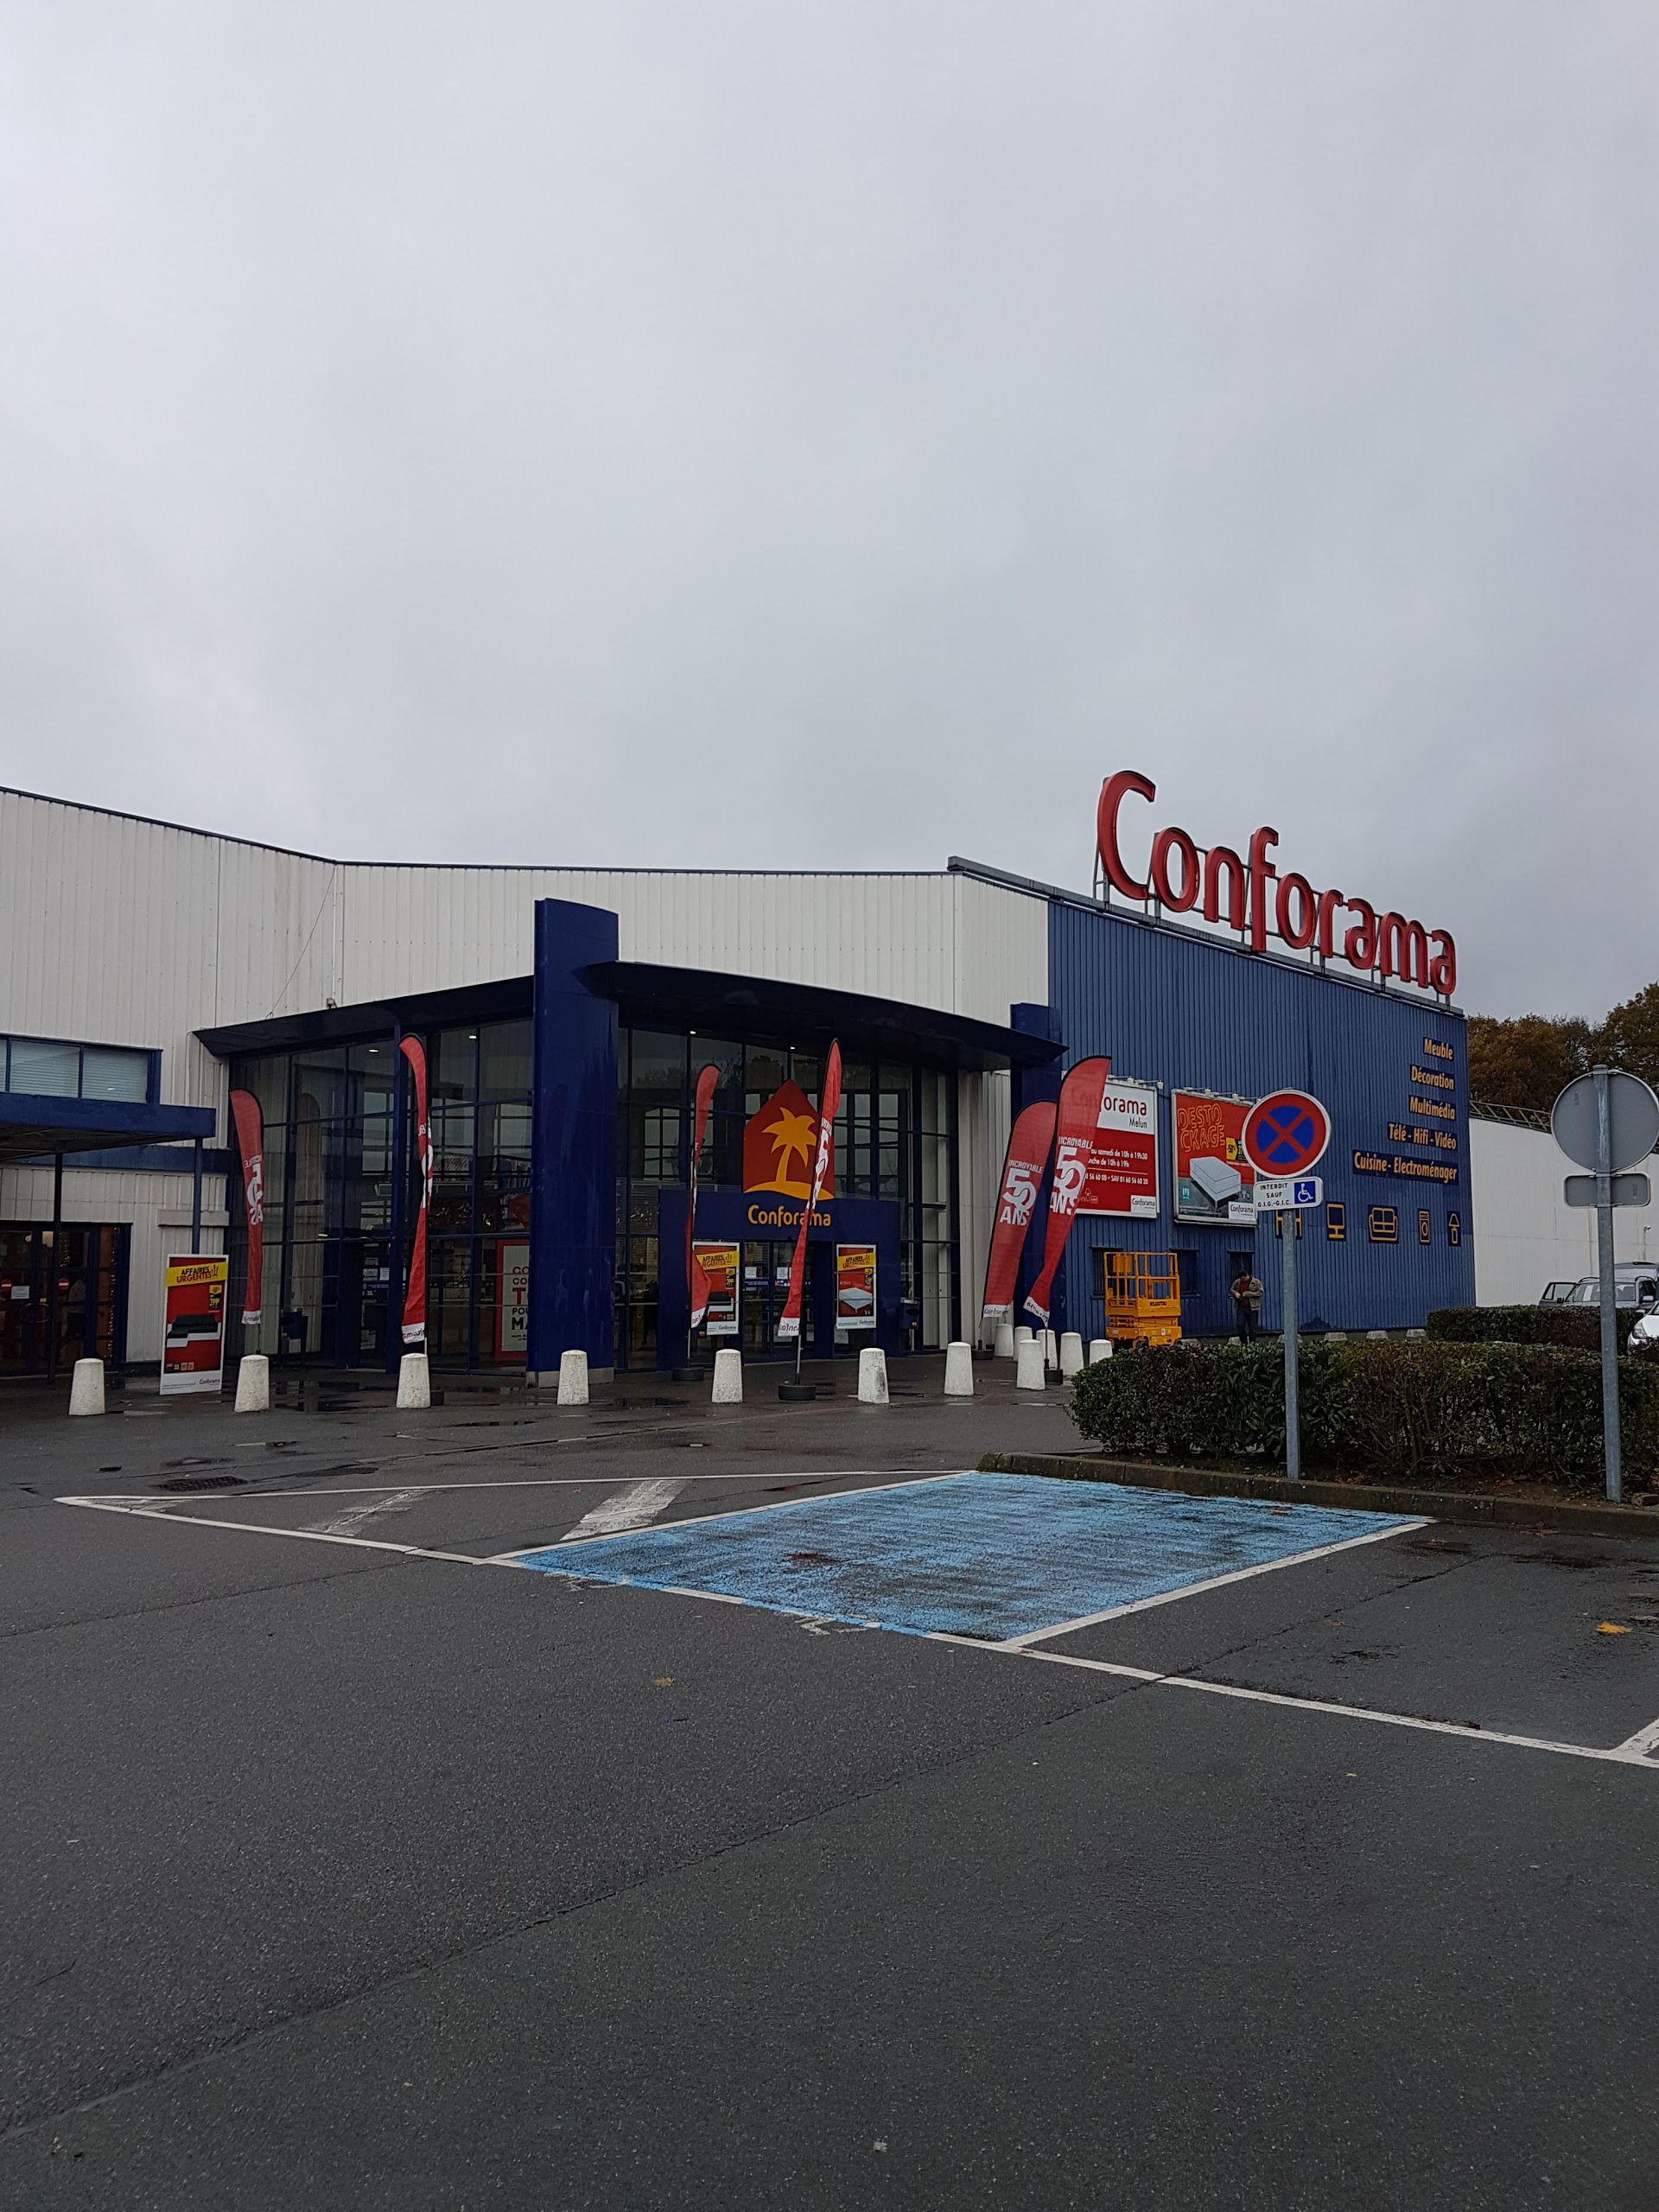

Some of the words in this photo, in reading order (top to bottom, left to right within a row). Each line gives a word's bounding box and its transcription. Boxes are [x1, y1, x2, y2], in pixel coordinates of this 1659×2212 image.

[1096, 770, 1457, 995] Conforama
[1424, 1039, 1453, 1060] Meuble
[1411, 1065, 1454, 1090] Décoration
[1102, 1096, 1147, 1116] orama
[1177, 1103, 1223, 1131] DESTO
[1409, 1096, 1455, 1120] Multimédia
[1129, 1116, 1147, 1128] Melun
[1180, 1124, 1226, 1153] CKAGE
[1389, 1123, 1407, 1141] Télé
[1413, 1128, 1428, 1145] Hifi
[1434, 1131, 1457, 1150] Vidéo
[1053, 1145, 1087, 1199] 50
[1354, 1152, 1387, 1173] Cuisine
[1394, 1157, 1457, 1184] Electroménager
[1002, 1167, 1037, 1211] 50
[1132, 1198, 1155, 1207] Conforama
[1230, 1204, 1254, 1214] Conforama
[747, 1205, 831, 1227] Conforama
[1000, 1206, 1030, 1226] ANS
[181, 1266, 210, 1275] AFFAIRES
